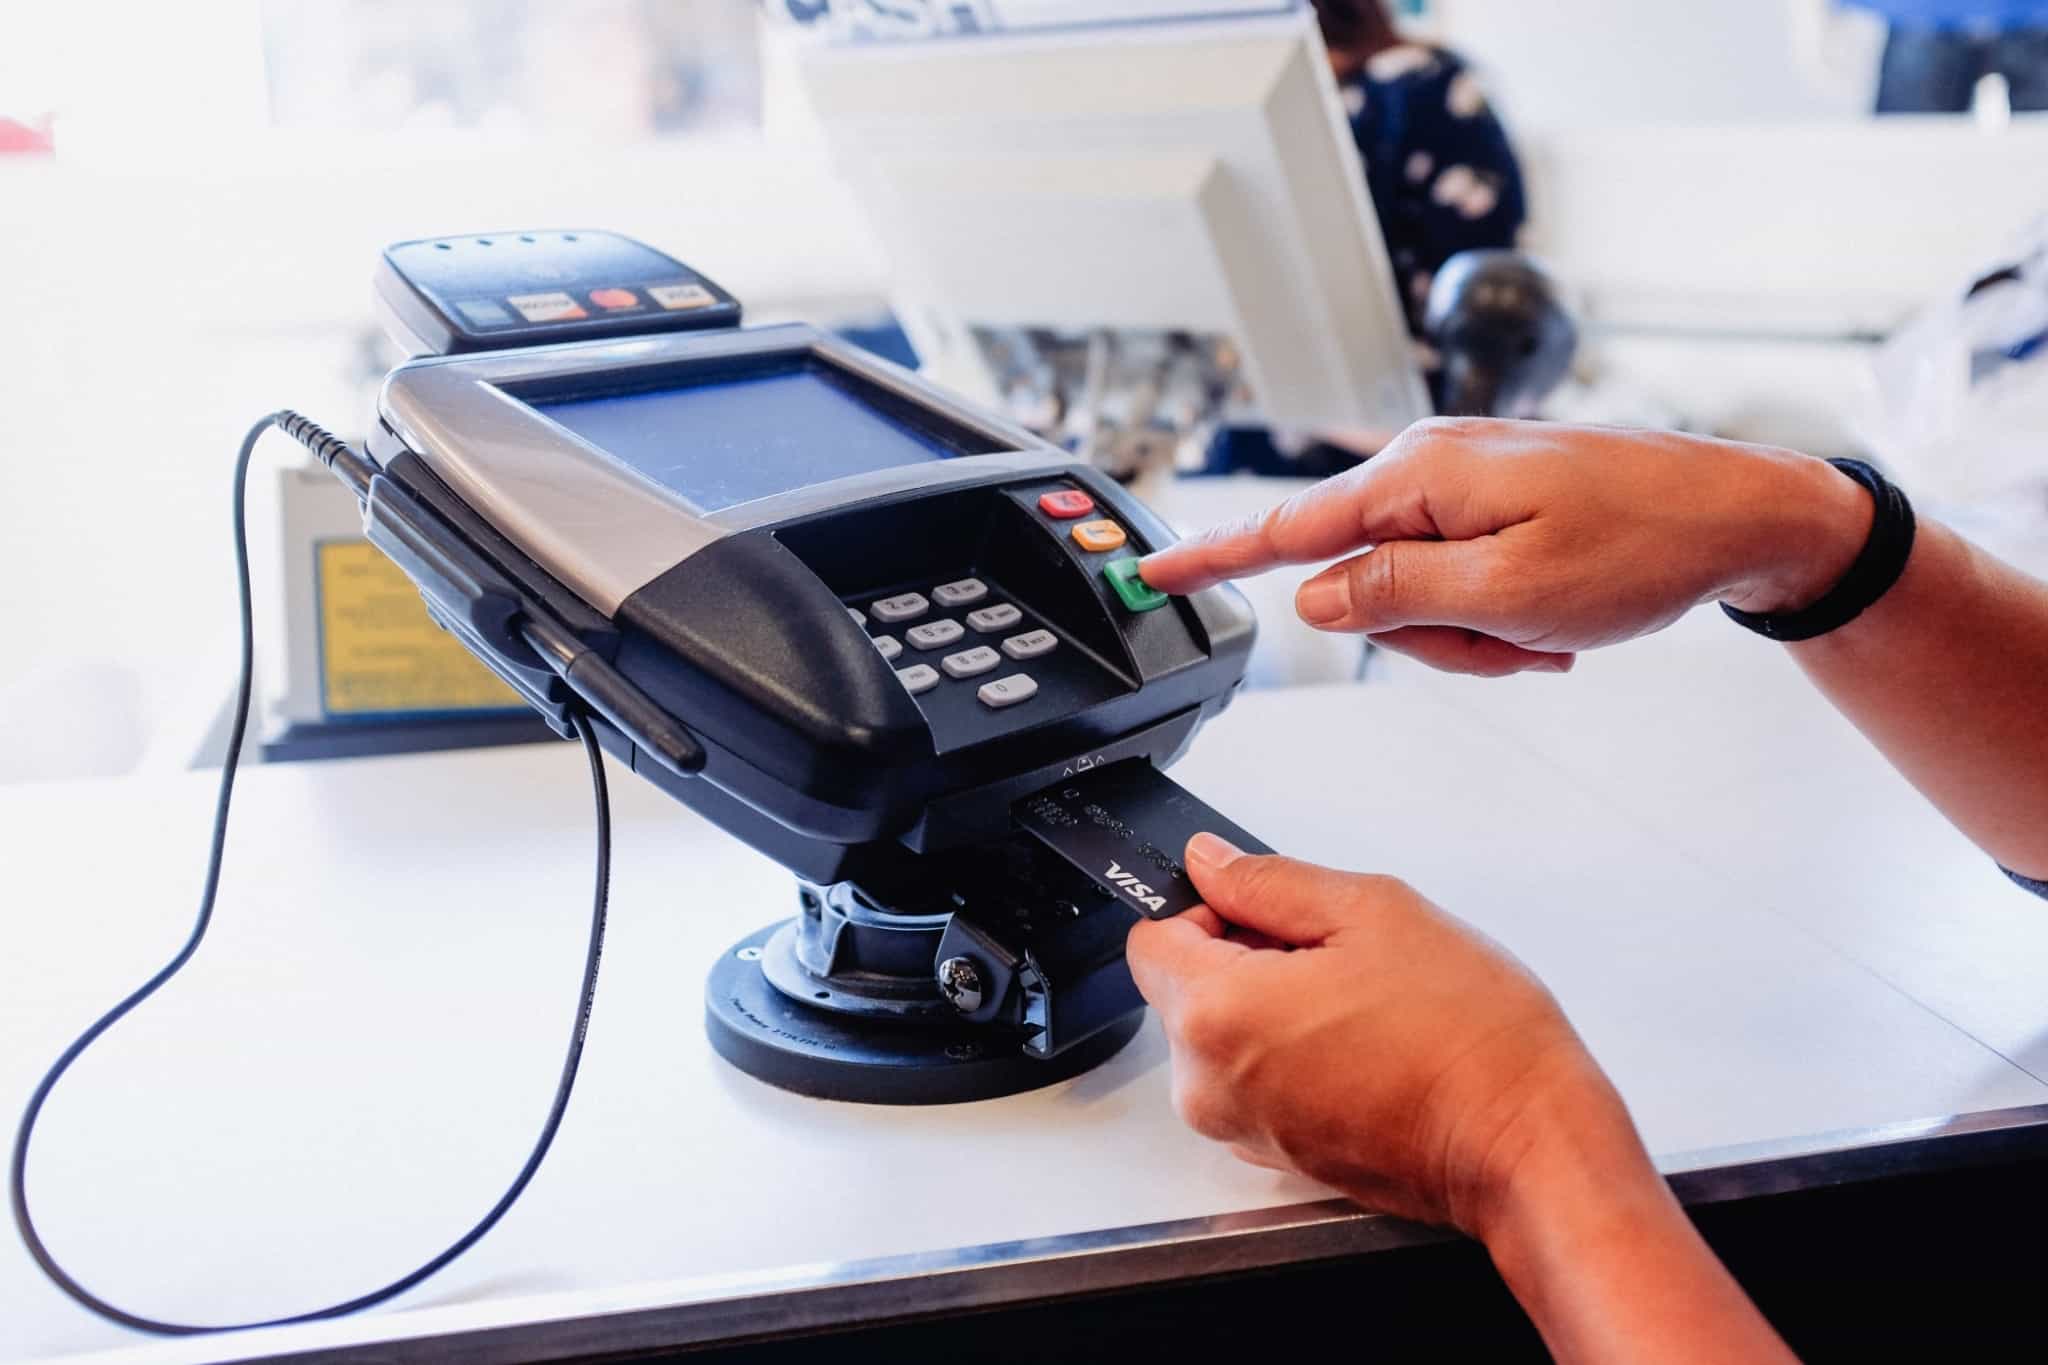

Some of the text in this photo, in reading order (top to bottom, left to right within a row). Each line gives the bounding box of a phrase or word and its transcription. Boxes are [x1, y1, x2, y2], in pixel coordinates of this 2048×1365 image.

[884, 600, 898, 609] 2
[922, 627, 936, 636] 5
[1104, 859, 1167, 912] VISA
